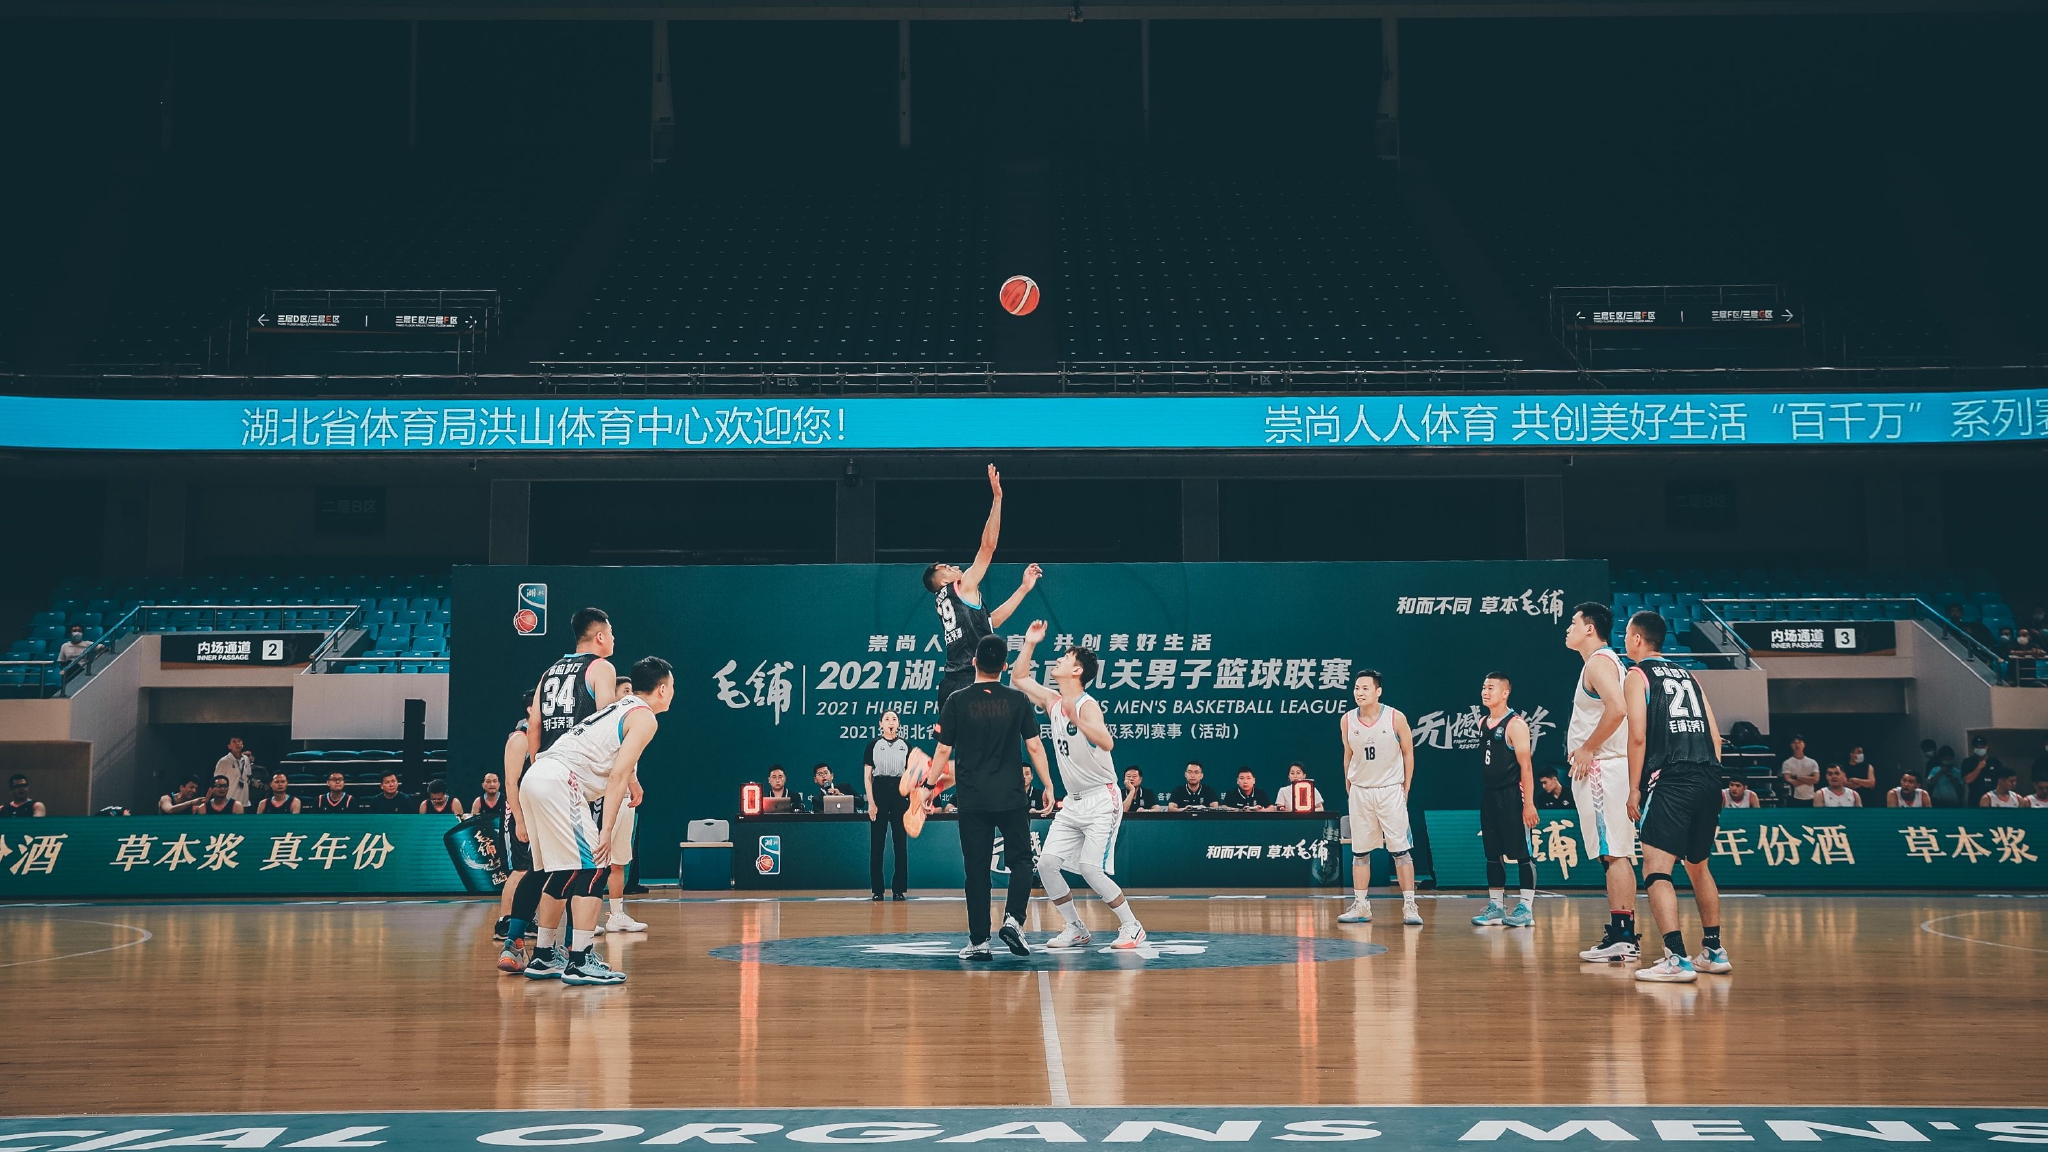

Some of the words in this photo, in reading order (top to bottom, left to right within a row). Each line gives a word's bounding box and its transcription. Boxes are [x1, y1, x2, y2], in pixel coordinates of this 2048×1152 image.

[241, 406, 846, 446] 湖北省体育局洪山体育中心欢迎您！
[1264, 402, 1498, 444] 崇尚人人体育
[1511, 401, 1748, 442] 共创美好生活
[1396, 596, 1473, 615] 和而不同
[867, 633, 1028, 652] 崇尚人育
[1053, 633, 1212, 652] 共创美好生活
[1770, 628, 1824, 643] 内场通道
[1840, 631, 1850, 645] 3
[197, 641, 251, 655] 内场通道
[267, 643, 278, 657] 2
[541, 674, 577, 716] 34
[1662, 677, 1703, 718] 21
[815, 701, 858, 716] 2021
[1113, 700, 1167, 714] MEN'S
[1172, 699, 1274, 714] BASKETBALL
[1279, 699, 1347, 714] LEAGUE
[1412, 704, 1557, 757] 无憾锋
[1364, 746, 1376, 760] 18
[1484, 749, 1491, 765] 6
[109, 833, 245, 872] 草本浆
[259, 831, 395, 871] 真年份
[1206, 844, 1263, 860] 和而不同
[1902, 825, 2039, 865] 草本浆
[476, 1120, 1382, 1144] ORGANS
